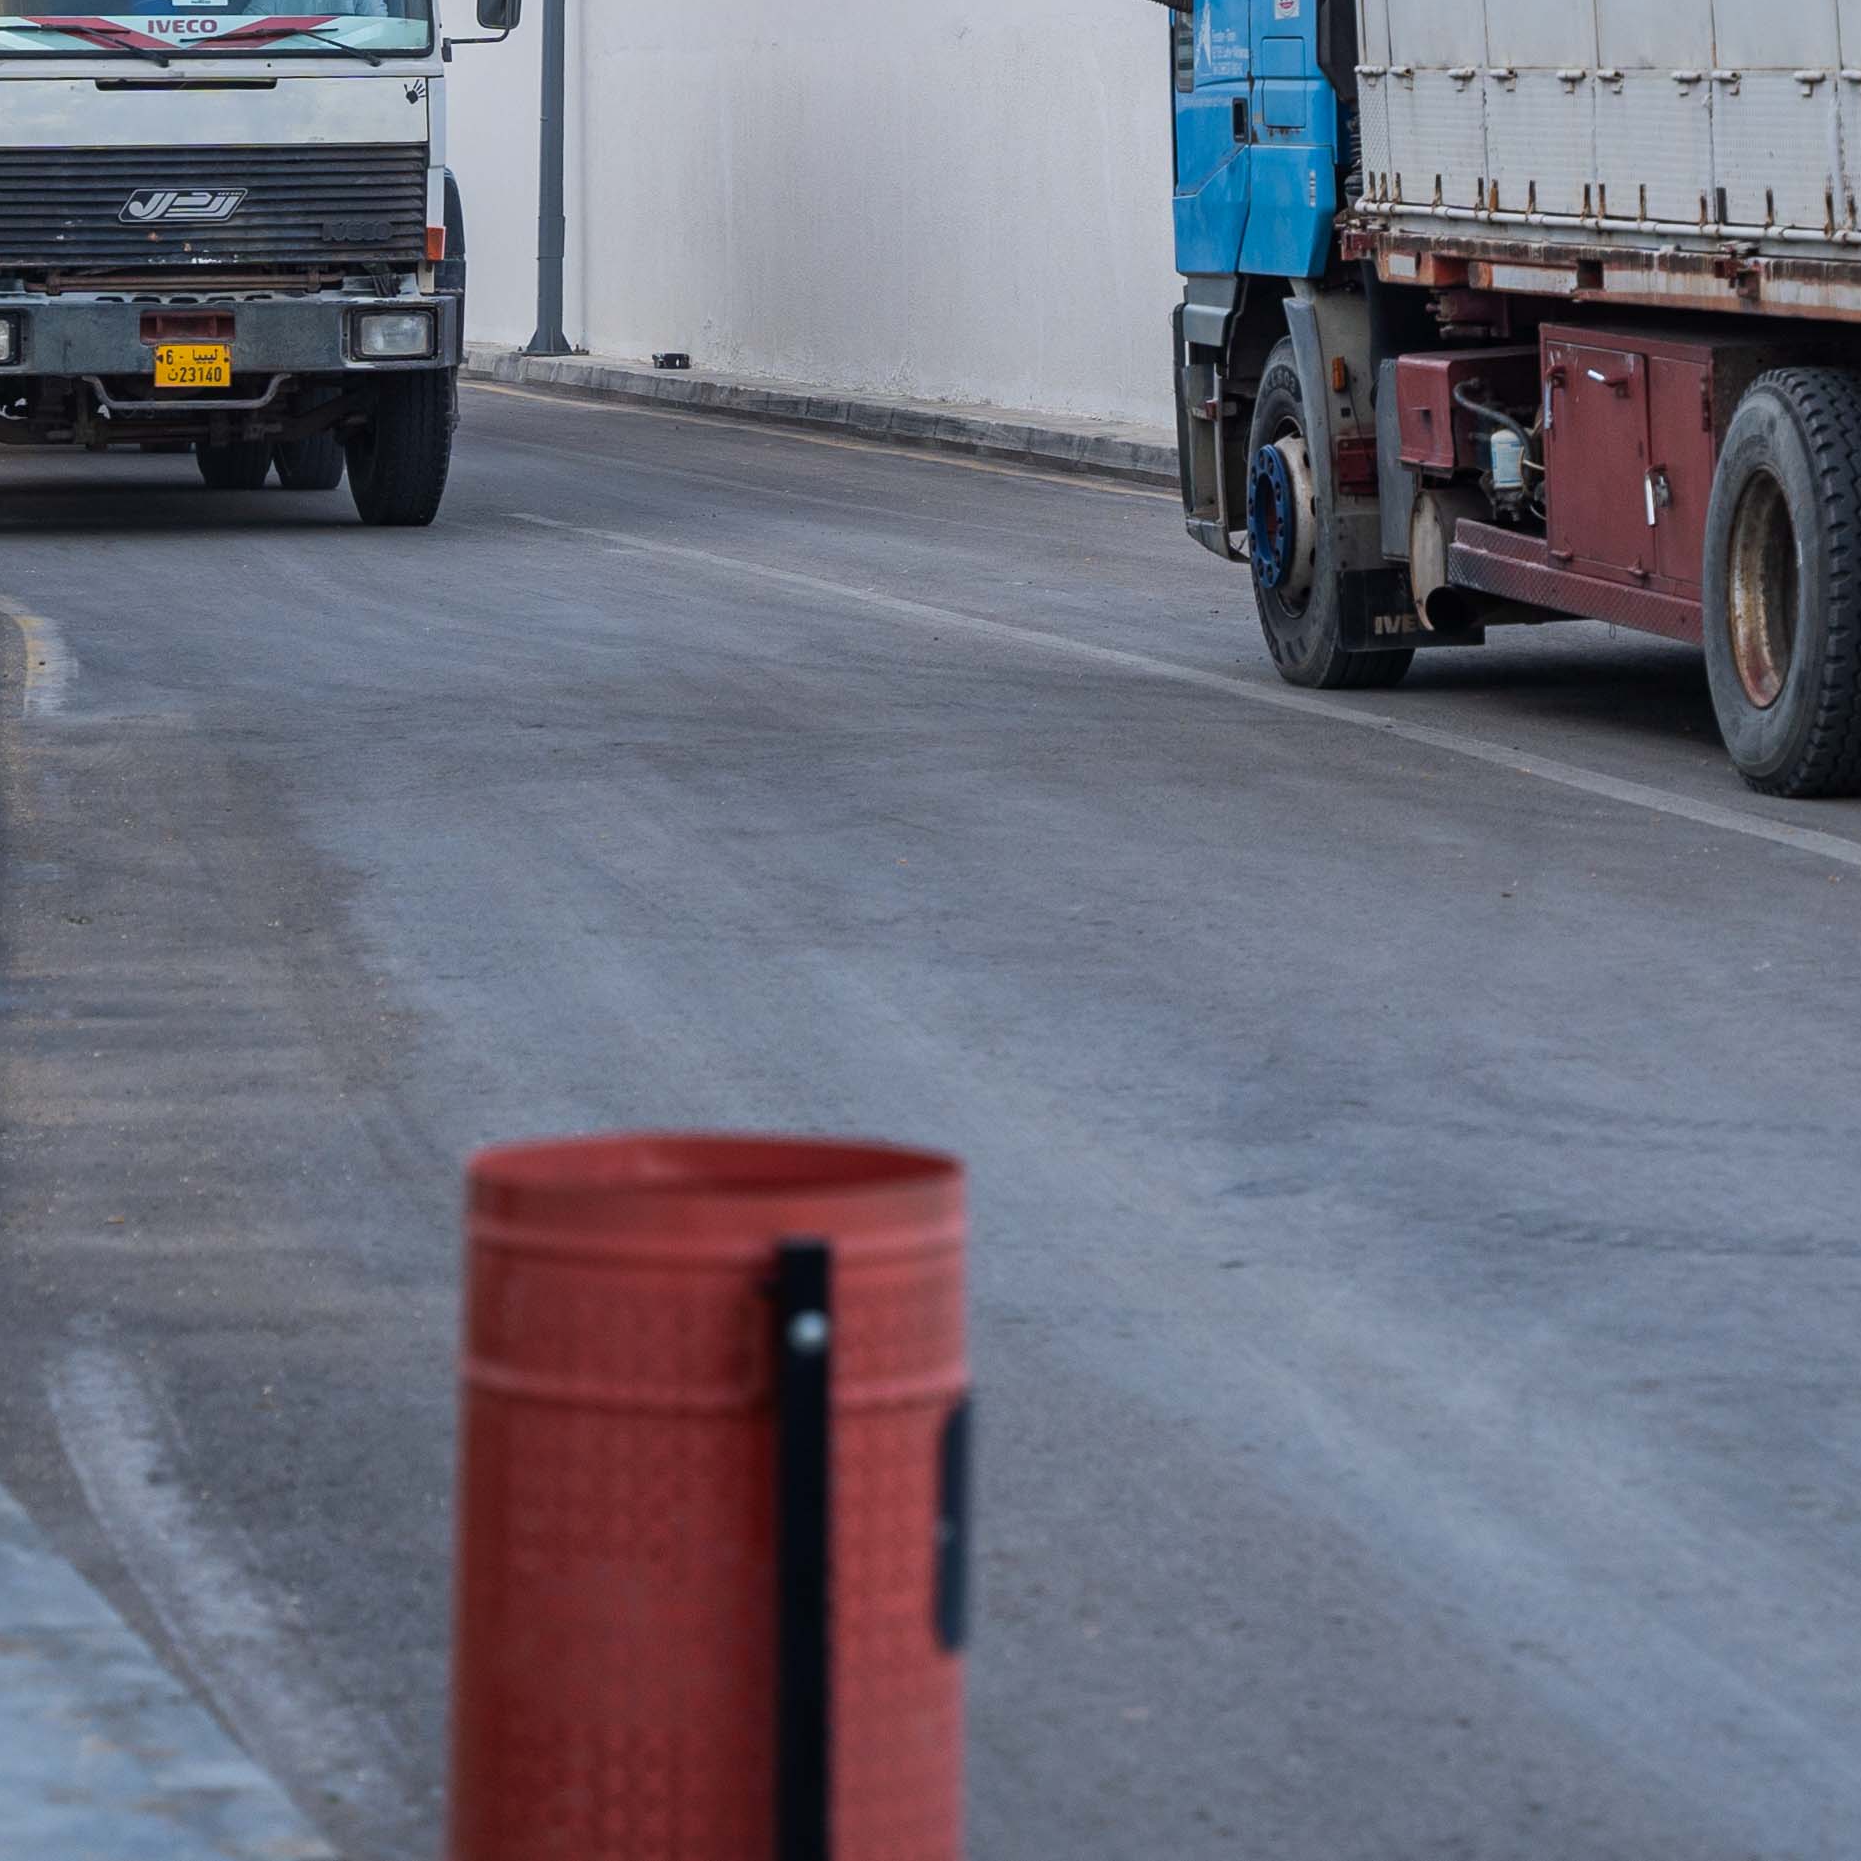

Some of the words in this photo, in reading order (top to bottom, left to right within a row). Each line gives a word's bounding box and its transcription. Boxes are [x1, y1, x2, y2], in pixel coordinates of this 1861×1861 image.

[147, 19, 218, 34] IVECO
[166, 349, 174, 365] 6
[192, 348, 218, 365] ليبيا
[1374, 614, 1424, 635] IVE
